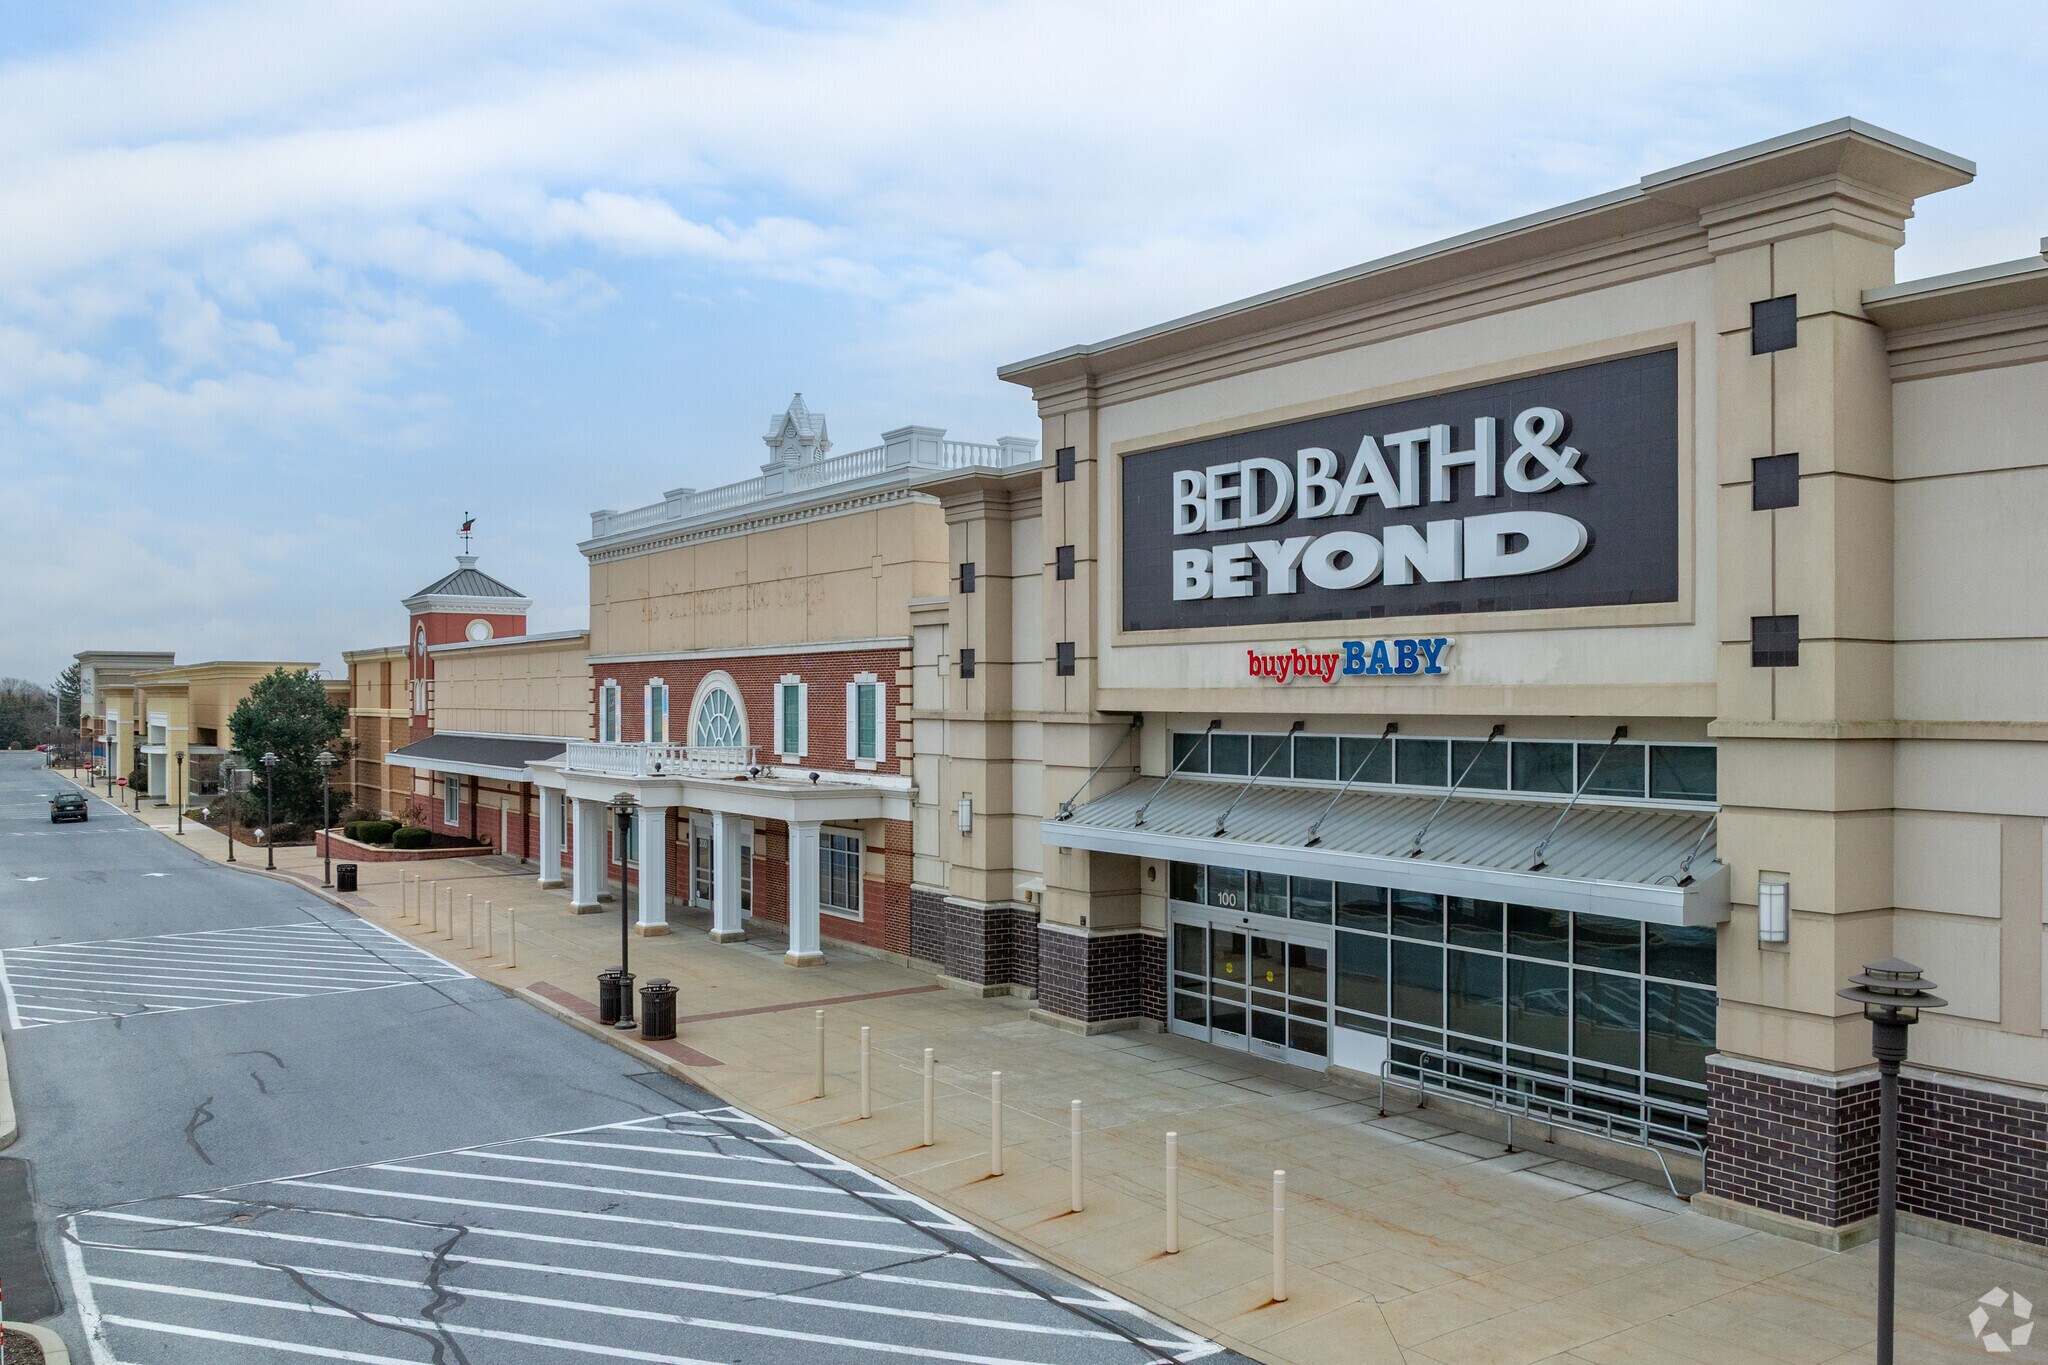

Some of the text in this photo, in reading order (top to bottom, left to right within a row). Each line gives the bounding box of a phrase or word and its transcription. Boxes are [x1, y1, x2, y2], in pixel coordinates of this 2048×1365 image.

[1173, 407, 1588, 535] BED BATH &
[1173, 511, 1588, 601] BEYOND
[1247, 638, 1454, 684] buybuy BABY
[1218, 891, 1237, 907] 100
